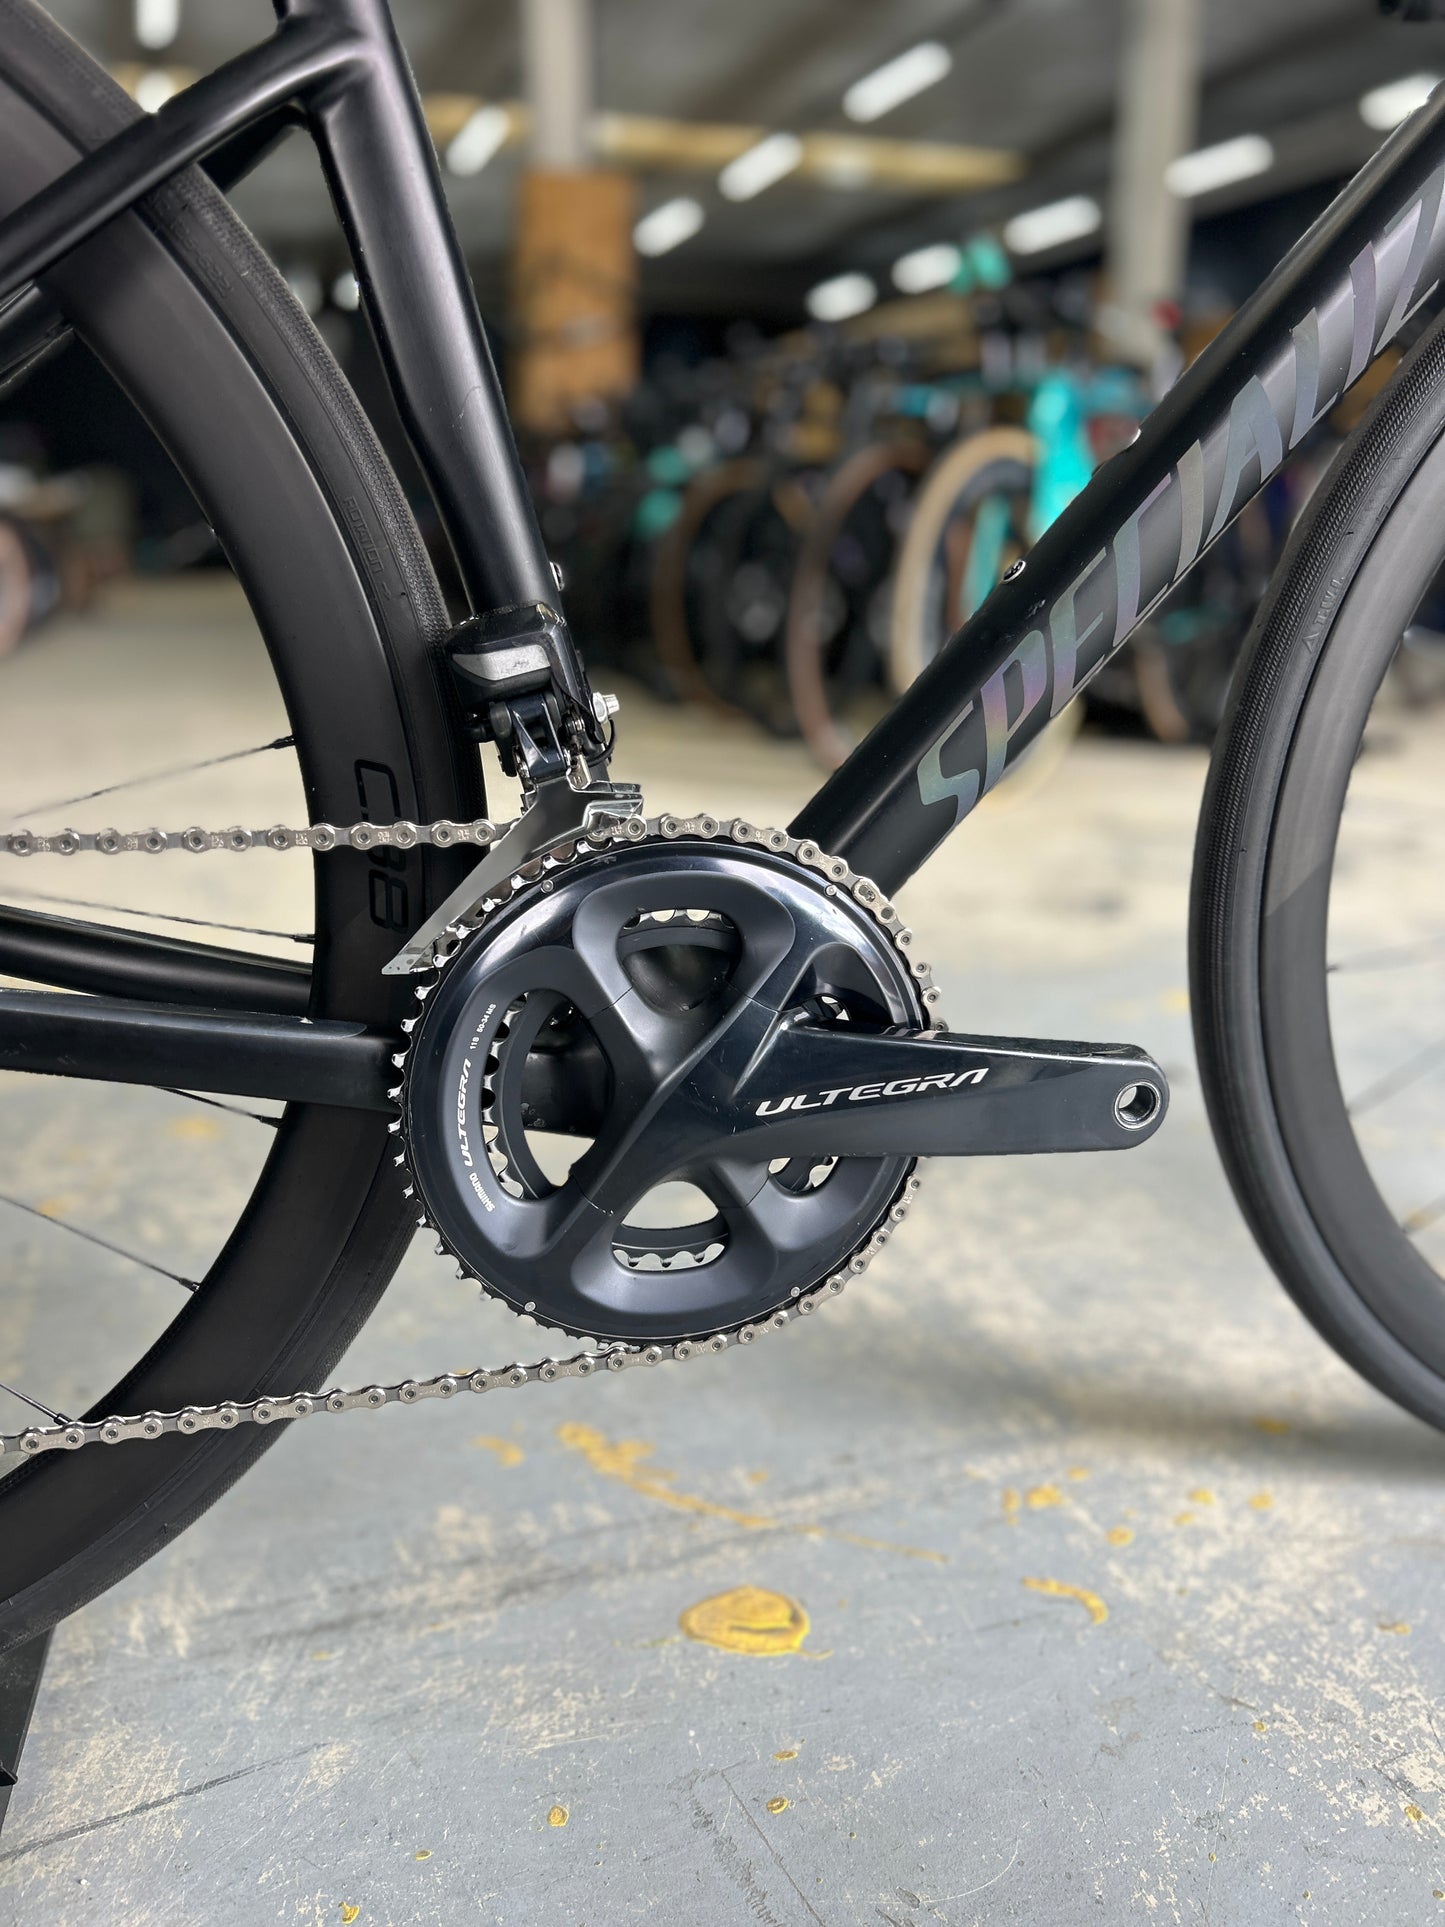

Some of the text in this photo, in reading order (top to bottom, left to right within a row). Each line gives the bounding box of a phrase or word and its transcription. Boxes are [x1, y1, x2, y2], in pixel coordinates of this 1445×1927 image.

[476, 1014, 490, 1033] 50-34
[457, 1058, 474, 1167] ULTEGRA
[755, 1067, 990, 1117] ULTEGRA
[469, 1172, 496, 1213] SHIMANO
